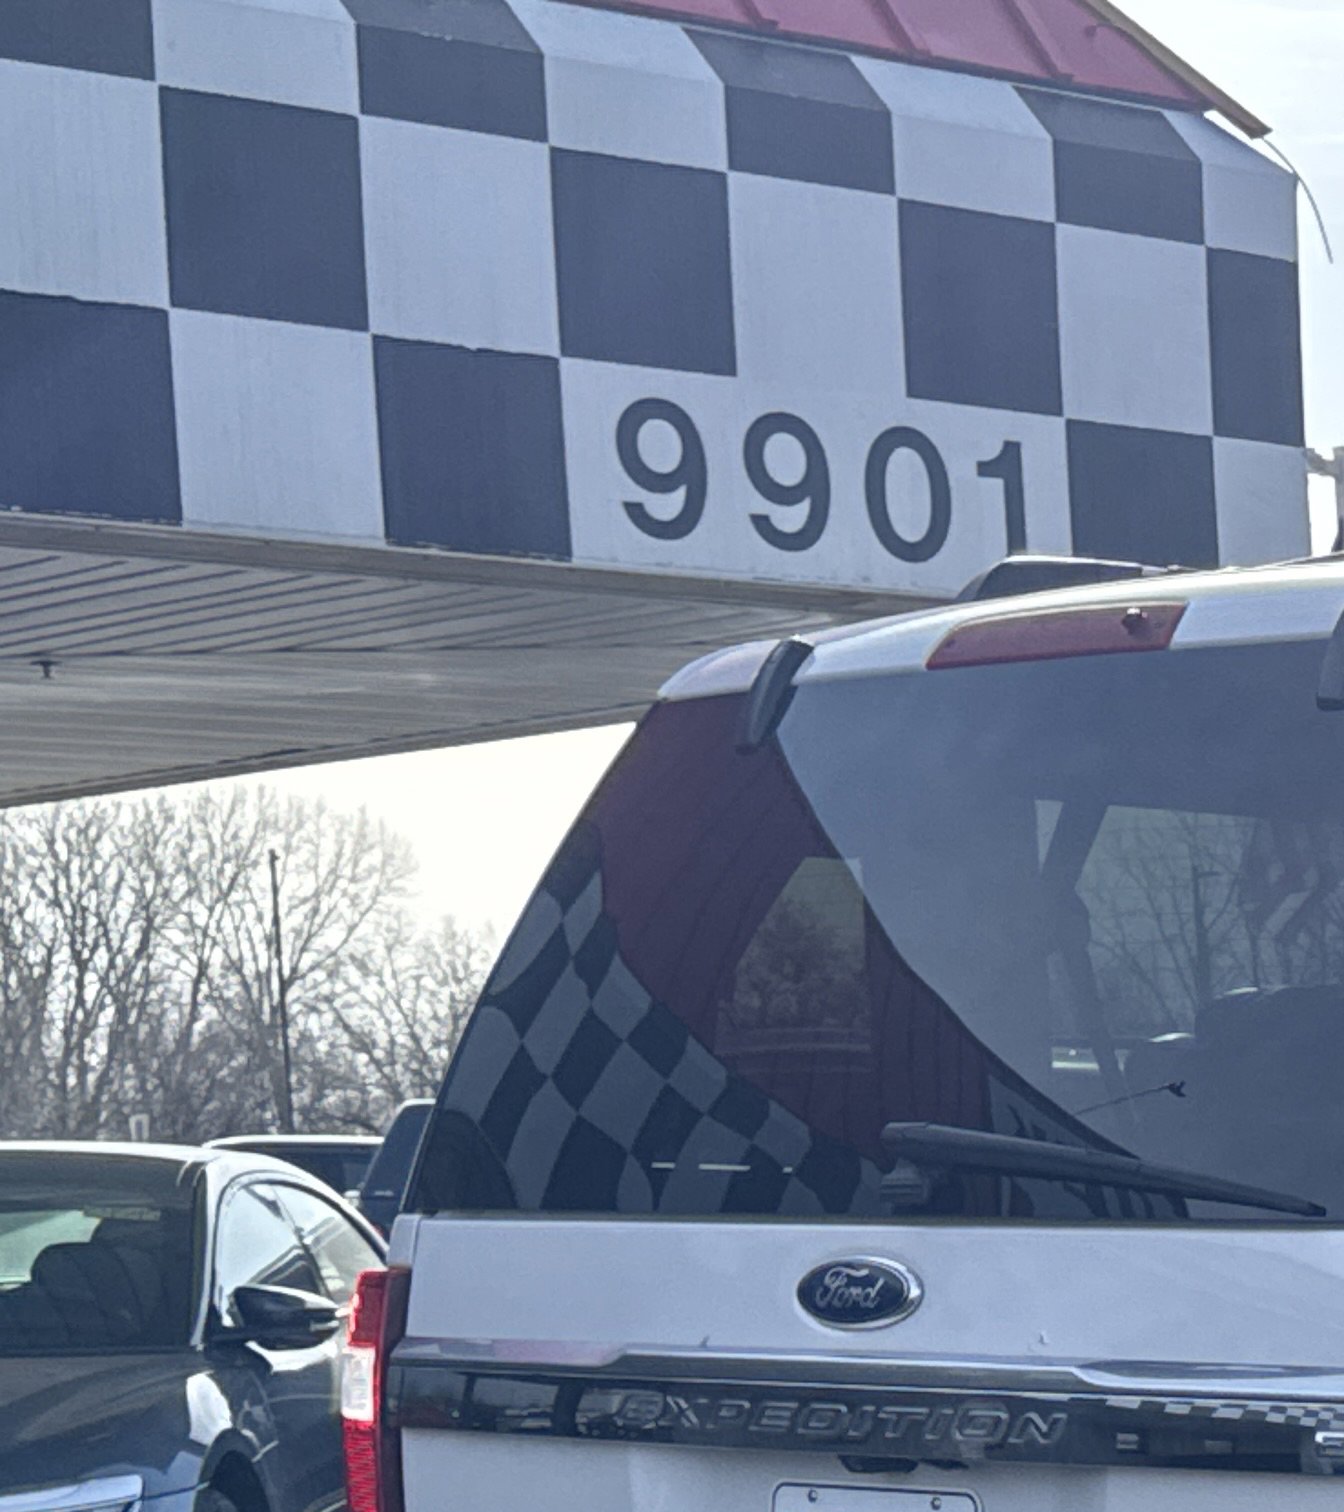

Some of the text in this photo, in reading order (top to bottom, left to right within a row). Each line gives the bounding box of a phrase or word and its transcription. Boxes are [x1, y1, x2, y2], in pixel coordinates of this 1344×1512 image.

[615, 397, 1028, 563] 9901
[815, 1266, 886, 1309] Ford
[612, 1390, 1069, 1445] EXPEDITION
